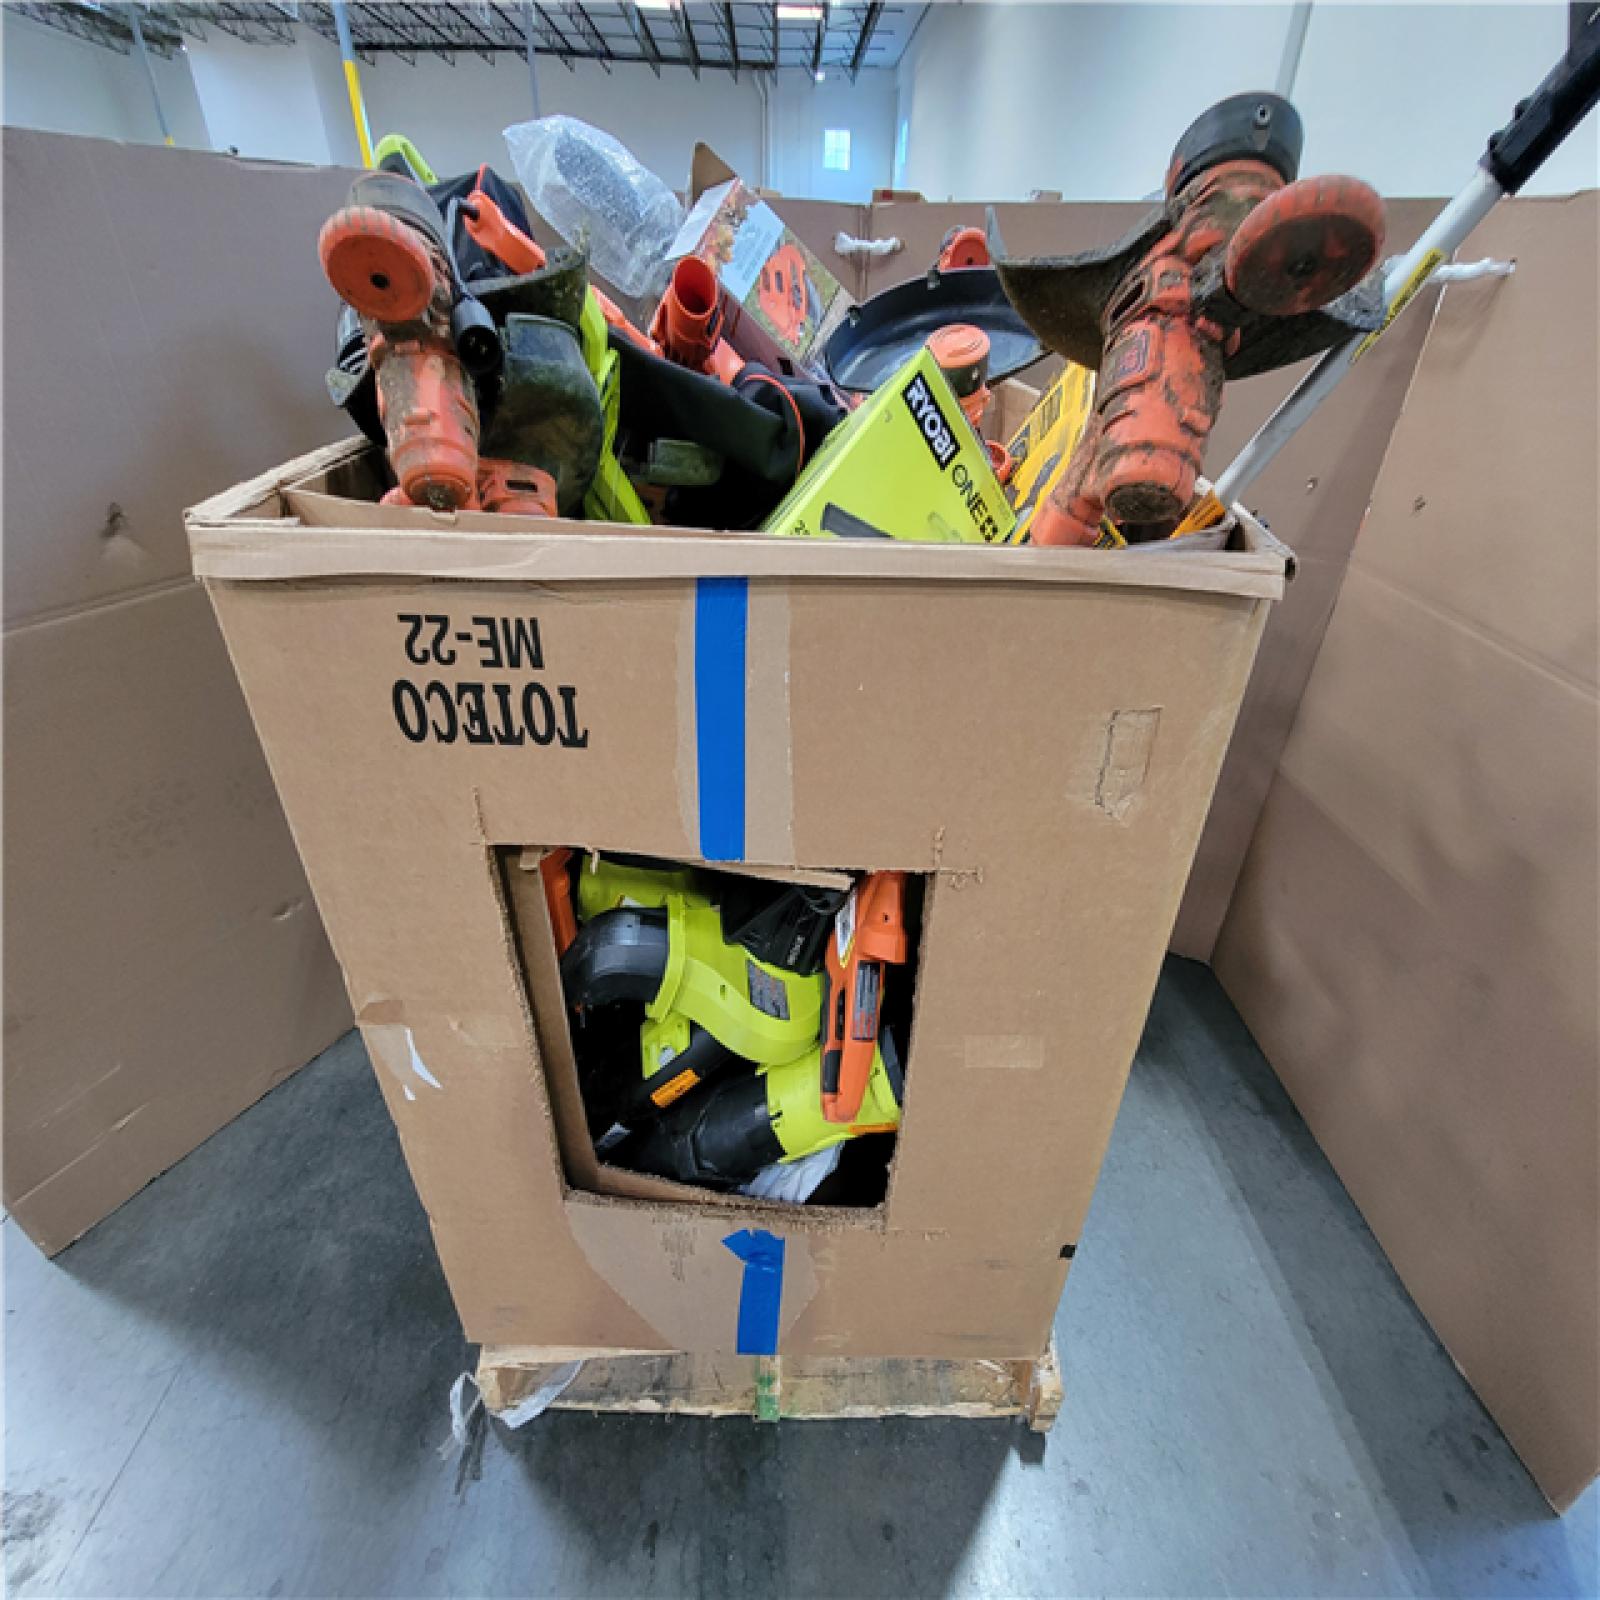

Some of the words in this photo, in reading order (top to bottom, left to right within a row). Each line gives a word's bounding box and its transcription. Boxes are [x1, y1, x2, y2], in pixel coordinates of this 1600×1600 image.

[905, 375, 957, 464] RYOBI
[397, 614, 545, 669] ME-22
[392, 679, 589, 748] TOTECO
